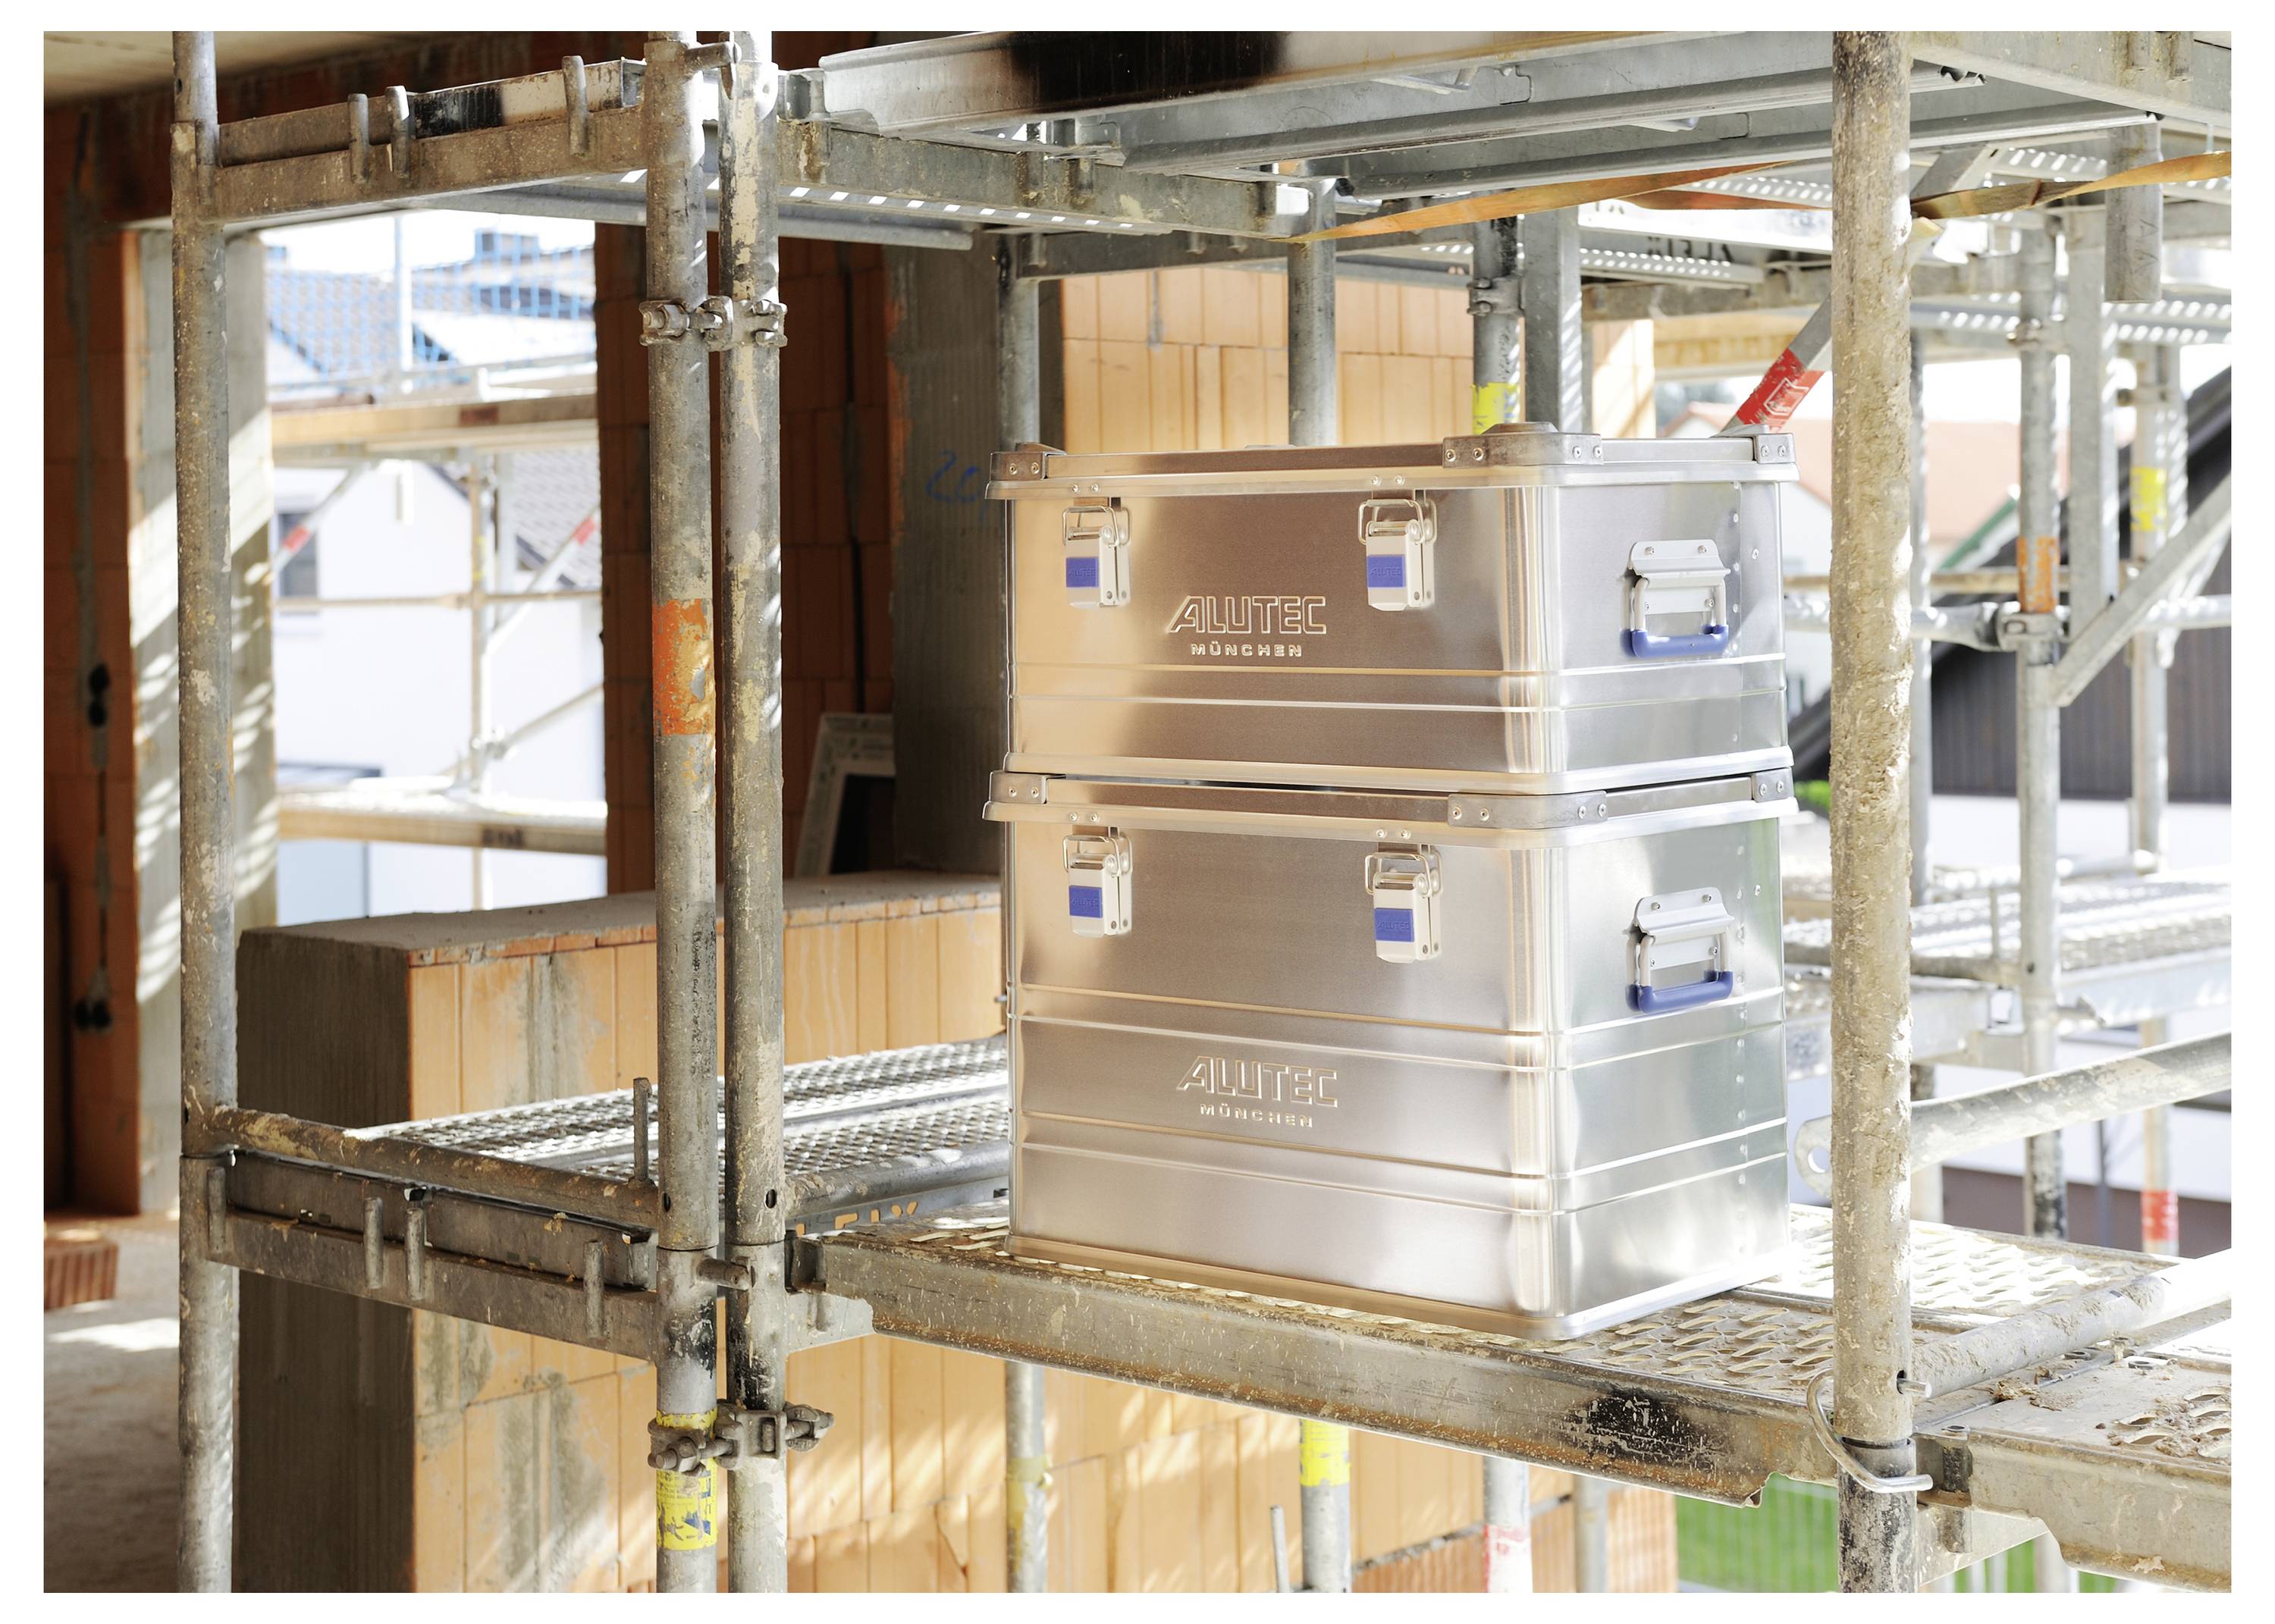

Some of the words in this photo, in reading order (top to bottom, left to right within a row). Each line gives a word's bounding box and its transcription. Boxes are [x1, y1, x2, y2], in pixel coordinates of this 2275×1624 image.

[1165, 595, 1326, 634] ALUTEC
[1191, 641, 1302, 657] MÜNCHEN
[1176, 1055, 1338, 1108] ALUTEC
[1200, 1103, 1313, 1127] MÜNCHEN
